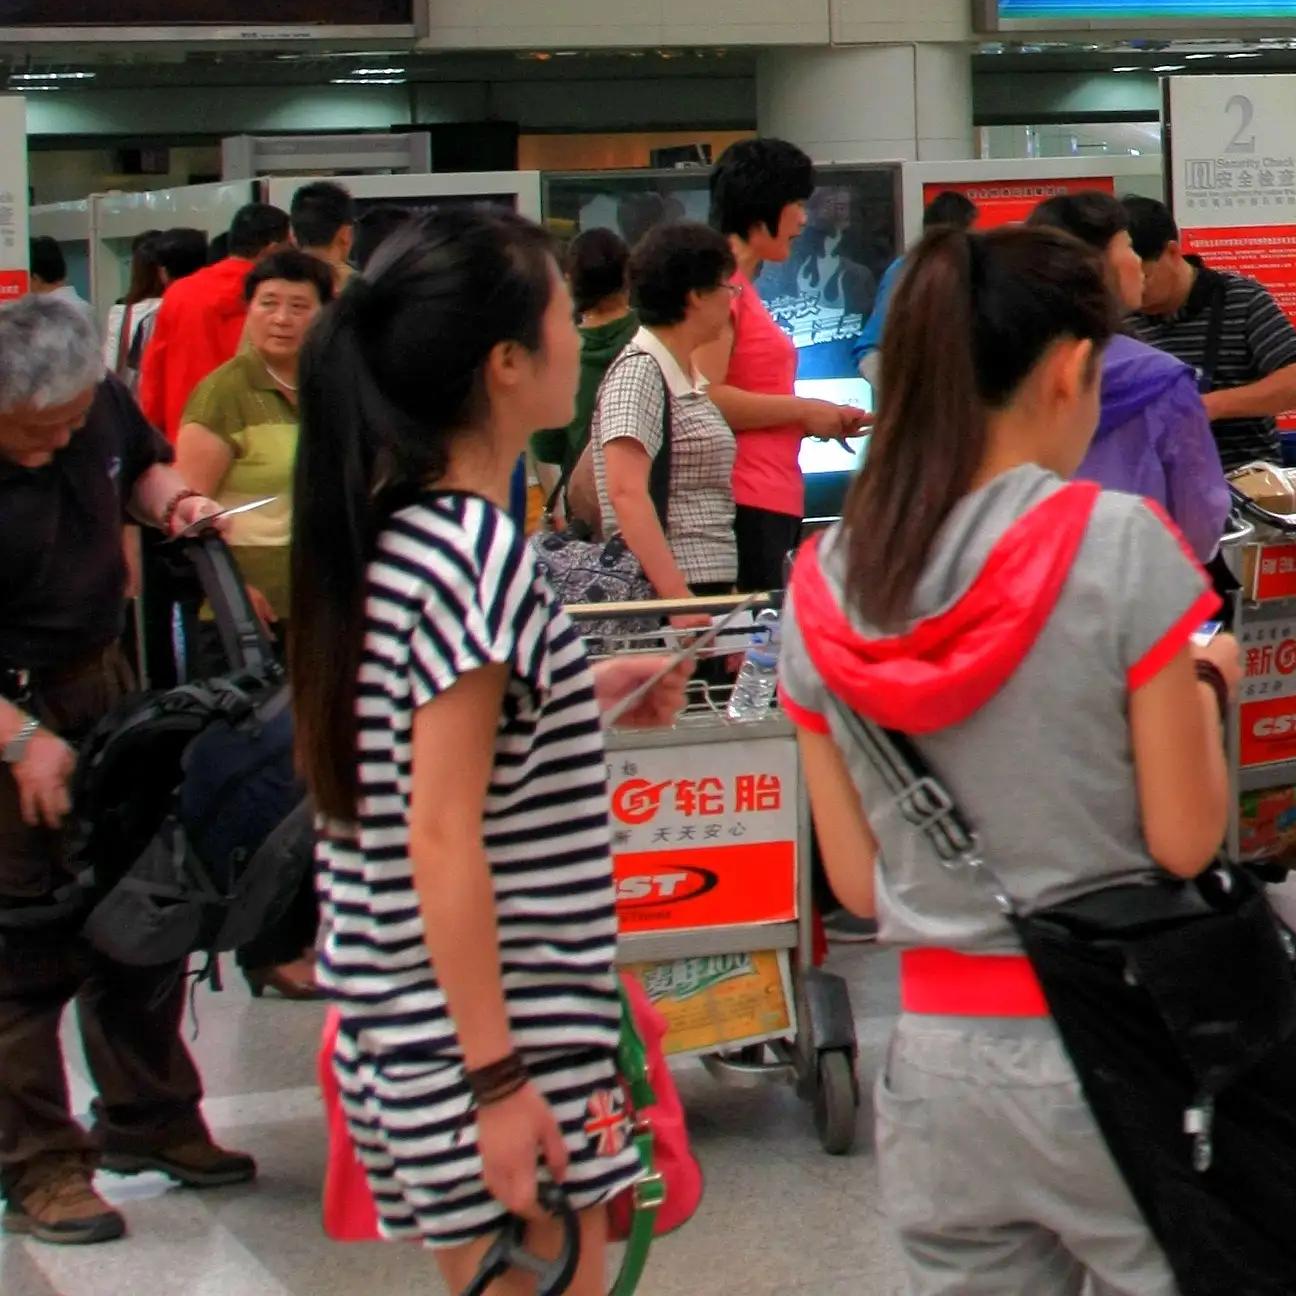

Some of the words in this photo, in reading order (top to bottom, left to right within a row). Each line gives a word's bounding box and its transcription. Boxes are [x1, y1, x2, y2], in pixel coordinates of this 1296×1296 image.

[1224, 94, 1255, 154] 2
[674, 773, 782, 817] 轮胎
[652, 821, 747, 843] 天天安心
[614, 872, 688, 900] ST
